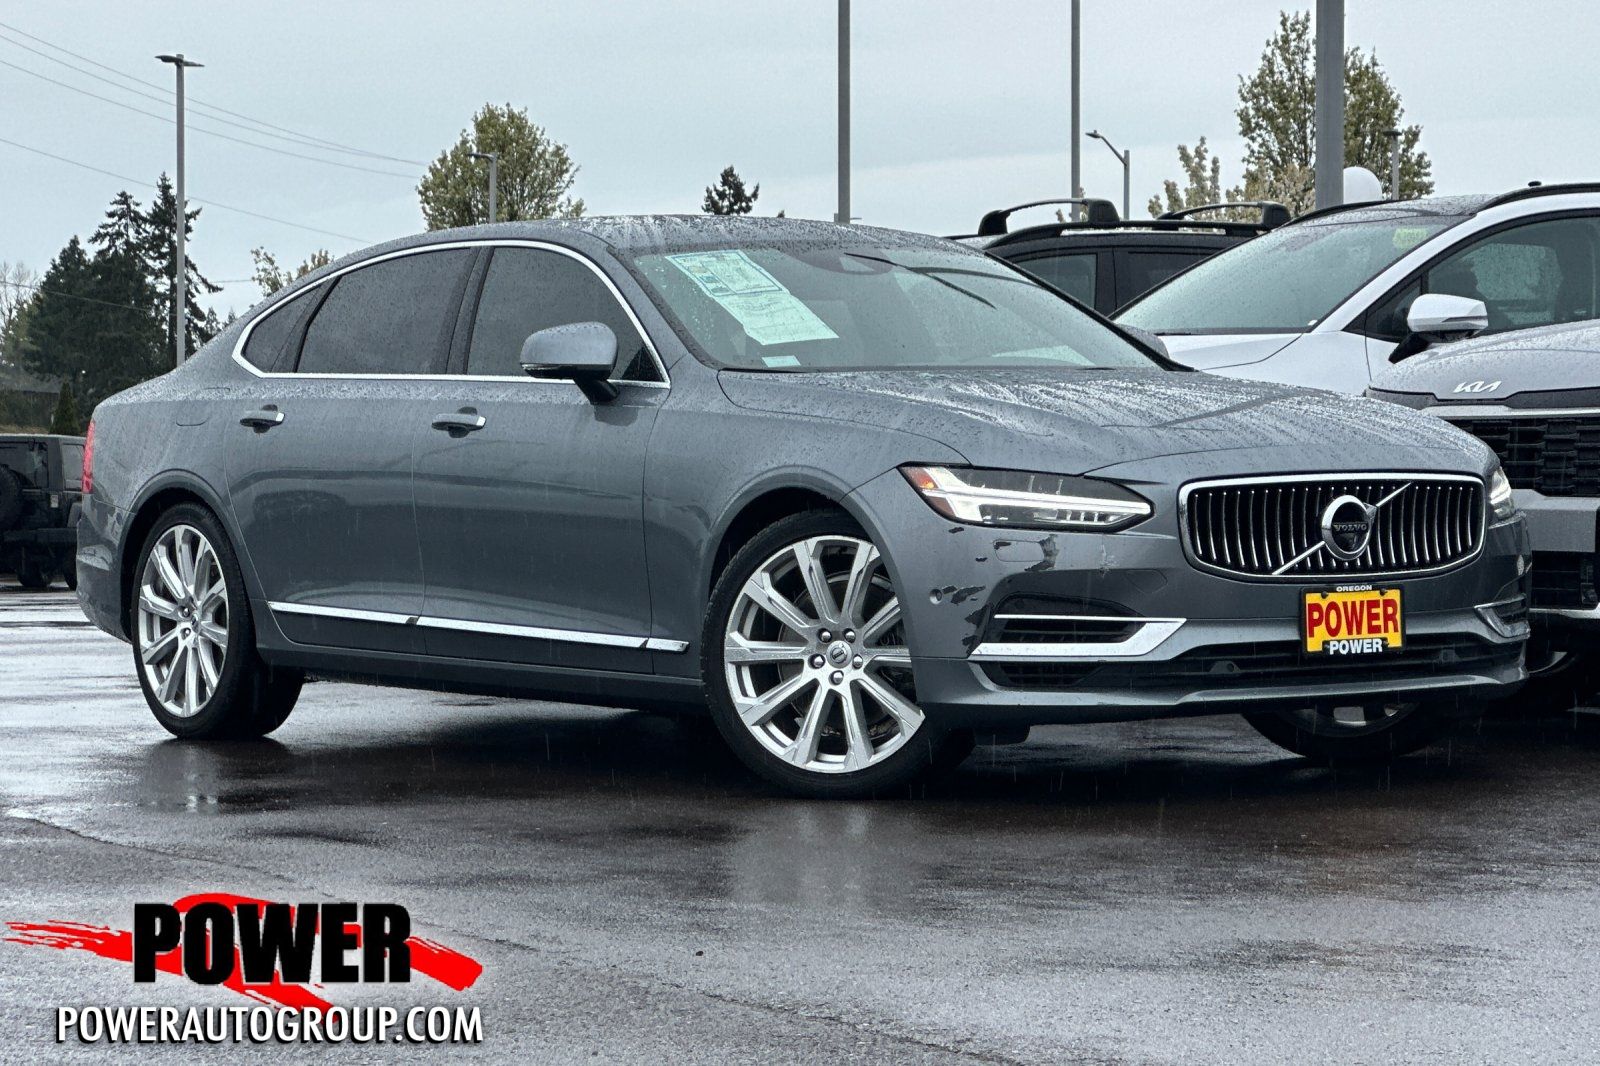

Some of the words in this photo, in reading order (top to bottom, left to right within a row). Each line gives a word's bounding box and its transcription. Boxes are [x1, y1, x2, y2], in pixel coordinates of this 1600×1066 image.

[1453, 380, 1502, 393] KIA
[1333, 522, 1367, 532] VOLVO
[1336, 584, 1373, 592] OREGON
[1308, 598, 1399, 638] POWER
[1329, 638, 1383, 655] POWER
